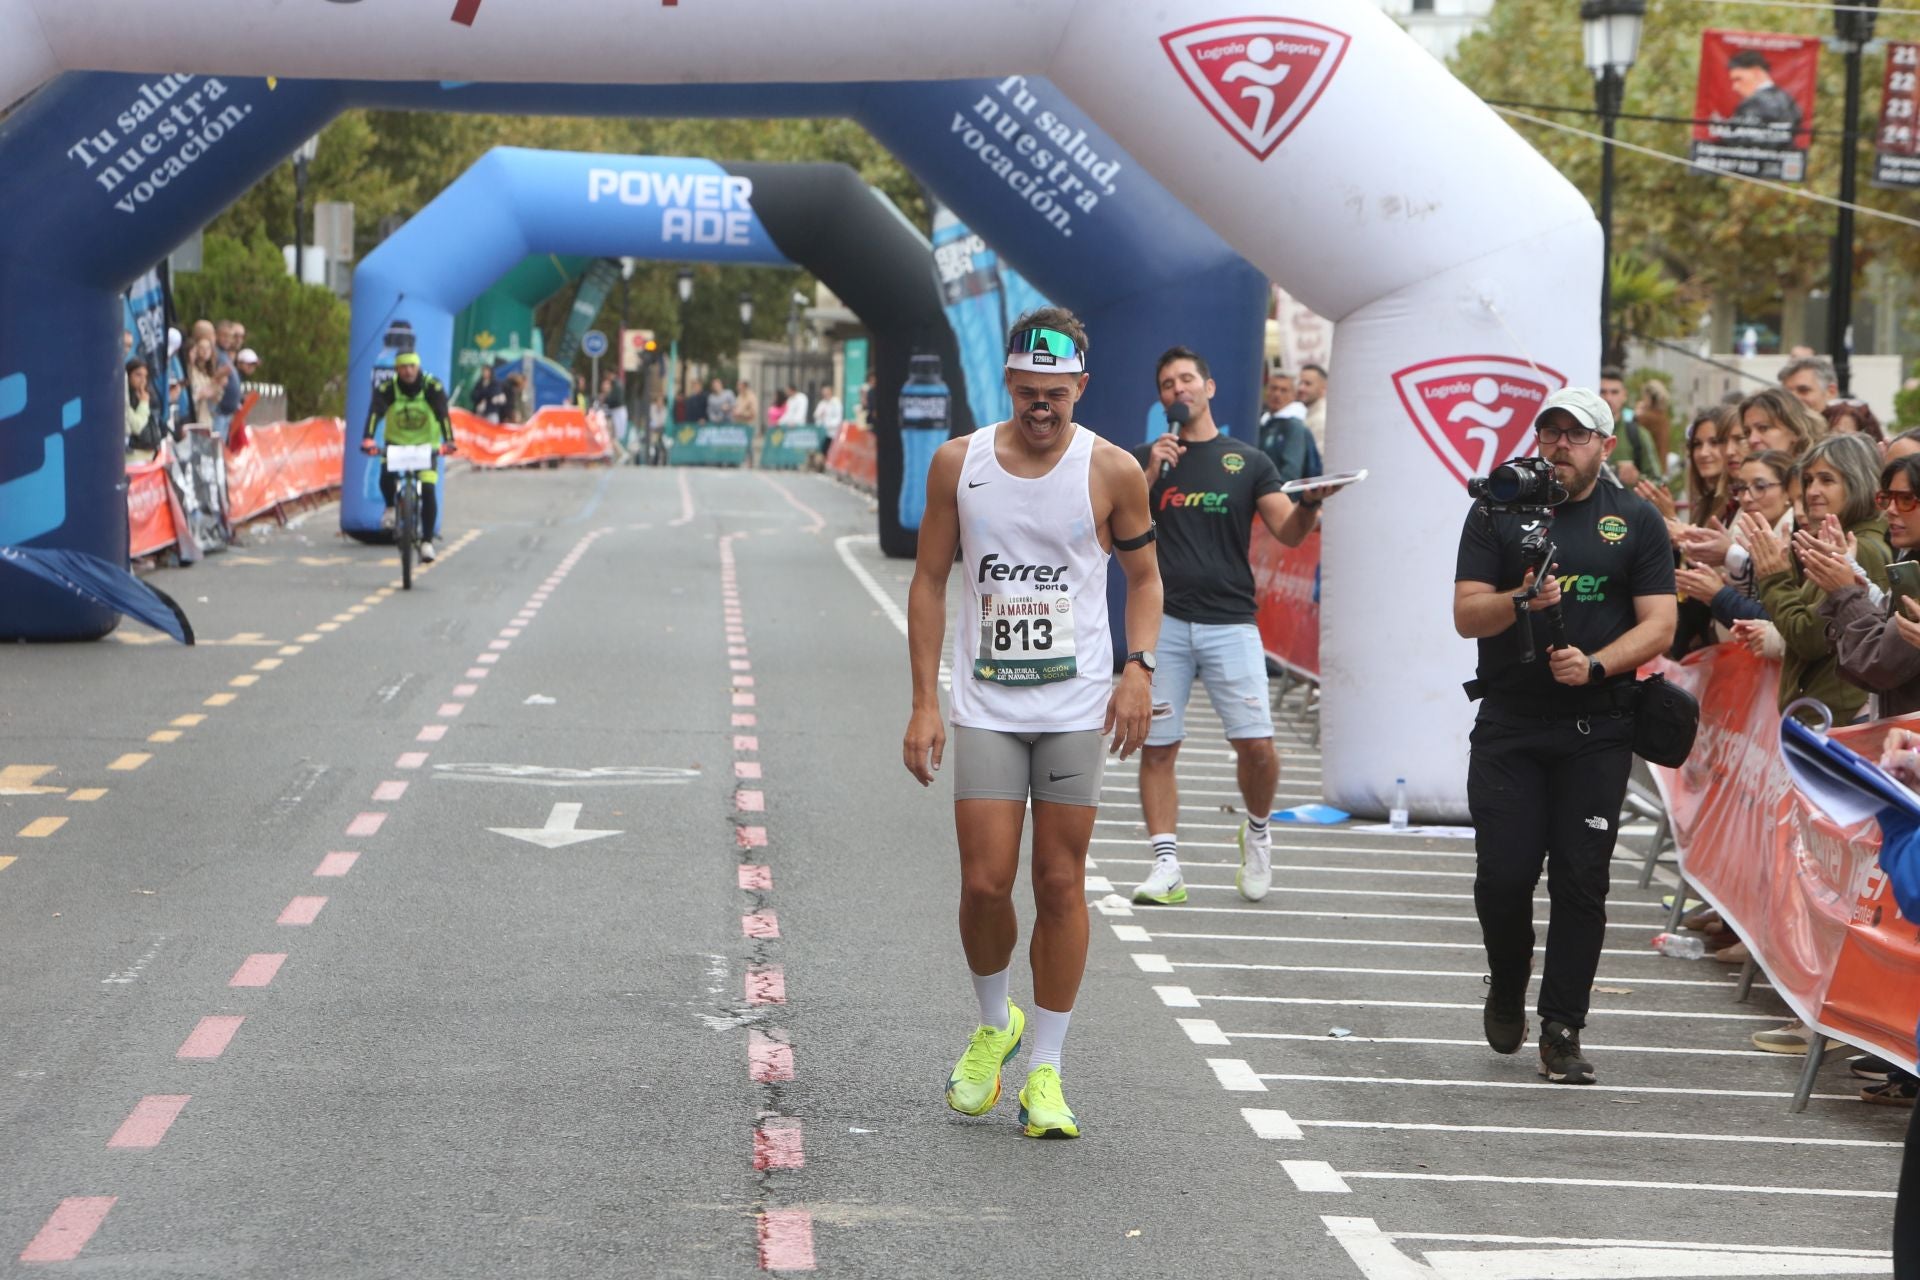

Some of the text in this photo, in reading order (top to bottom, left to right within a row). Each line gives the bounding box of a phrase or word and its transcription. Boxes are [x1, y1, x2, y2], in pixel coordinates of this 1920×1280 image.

[1197, 40, 1321, 61] Logroño deporte
[67, 73, 195, 169] Tu salu
[96, 78, 228, 192] nuestra
[114, 104, 253, 214] vocación.
[973, 95, 1099, 214] nuestra
[1034, 111, 1122, 196] salud,
[588, 168, 753, 210] POWER
[951, 112, 1073, 238] vocación.
[661, 207, 753, 245] ADE
[1424, 381, 1543, 401] Logroño deporte
[1160, 485, 1229, 511] Ferrer
[978, 553, 1068, 583] Ferrer
[1035, 583, 1059, 592] sport
[997, 603, 1006, 616] LA
[1007, 601, 1050, 616] MARATÓN
[994, 618, 1053, 651] 813
[1042, 665, 1069, 673] ACCIÓN
